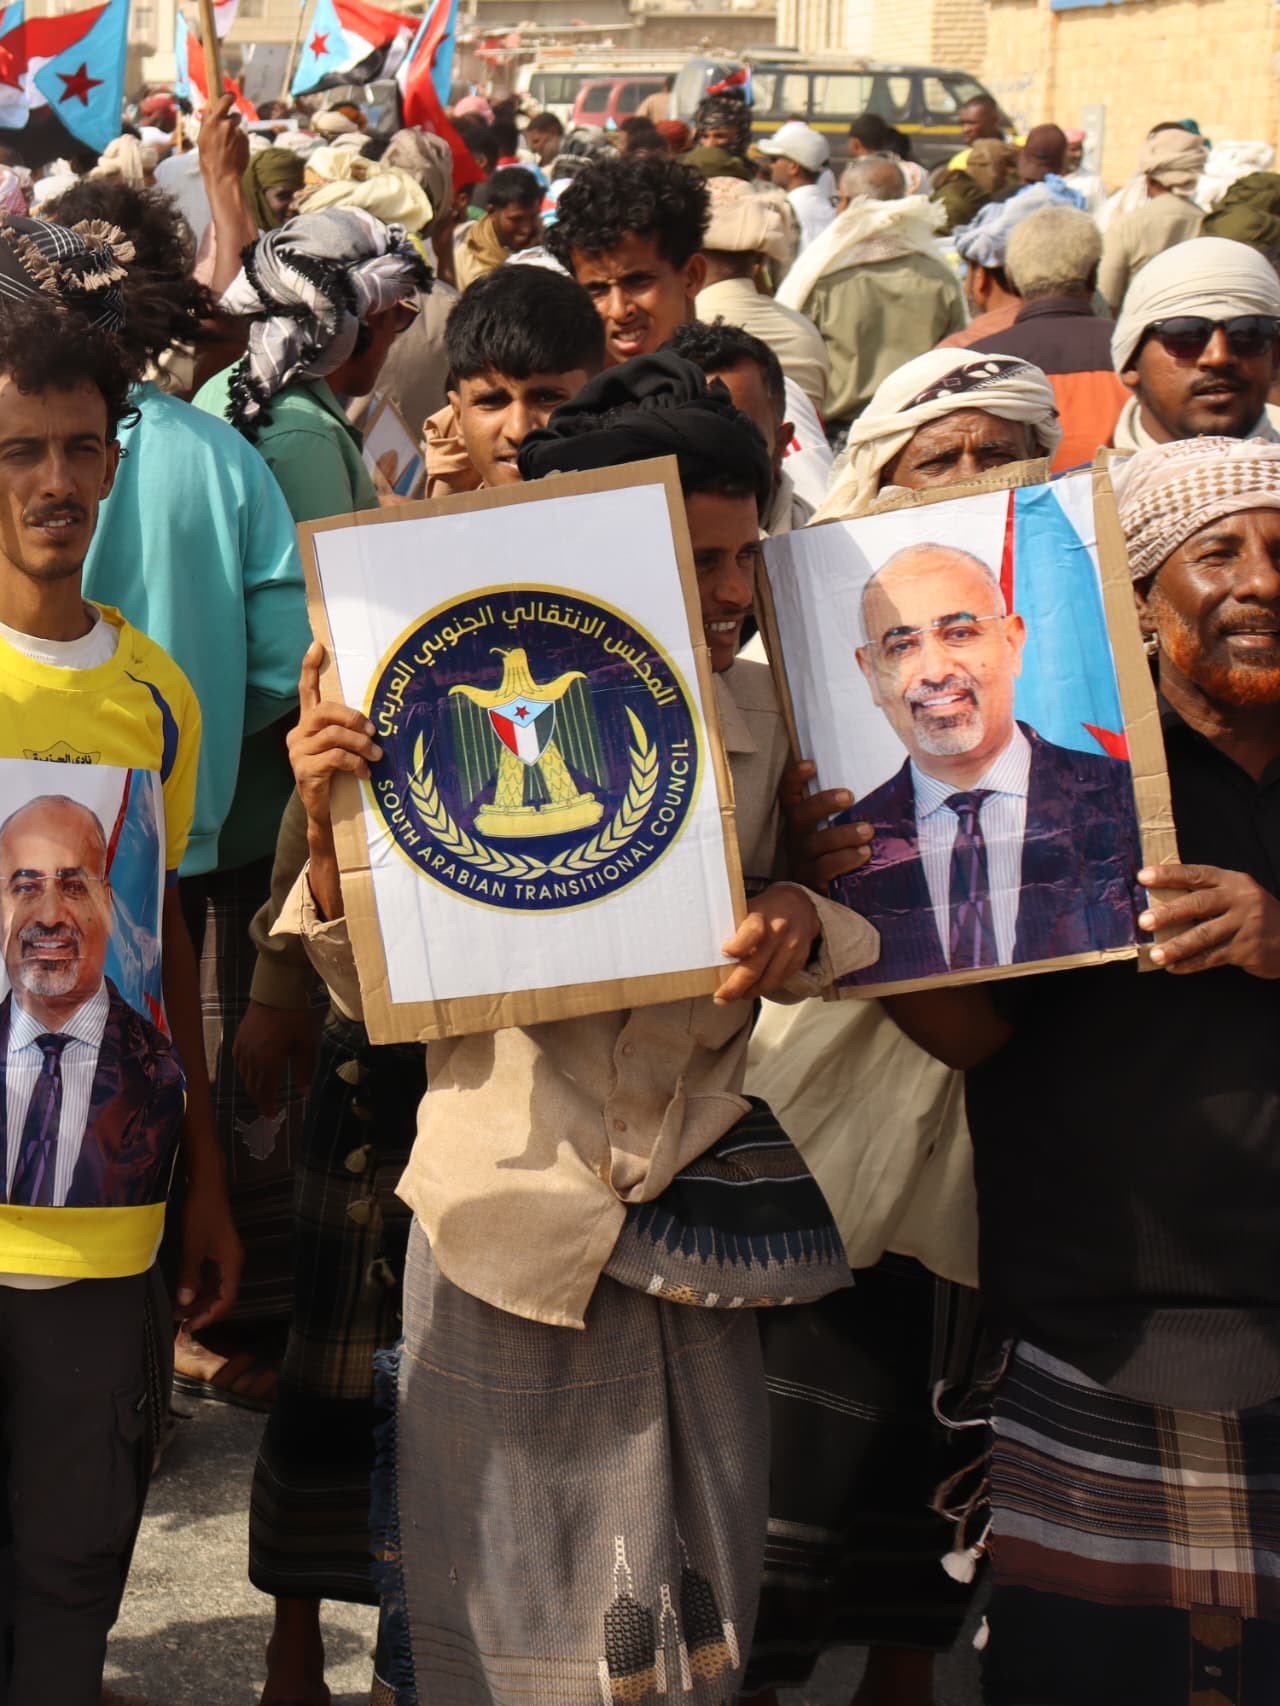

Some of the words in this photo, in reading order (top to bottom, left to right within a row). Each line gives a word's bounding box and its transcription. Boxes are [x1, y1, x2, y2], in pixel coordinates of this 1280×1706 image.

[413, 605, 494, 667] الجنوبي
[501, 602, 606, 639] الانتقالي
[377, 659, 415, 737] العربي
[603, 632, 677, 706] المجلس
[377, 779, 421, 847] SOUTH
[417, 847, 507, 898] ARABIAN
[514, 844, 654, 900] TRANSITIONAL
[651, 738, 688, 836] COUNCIL
